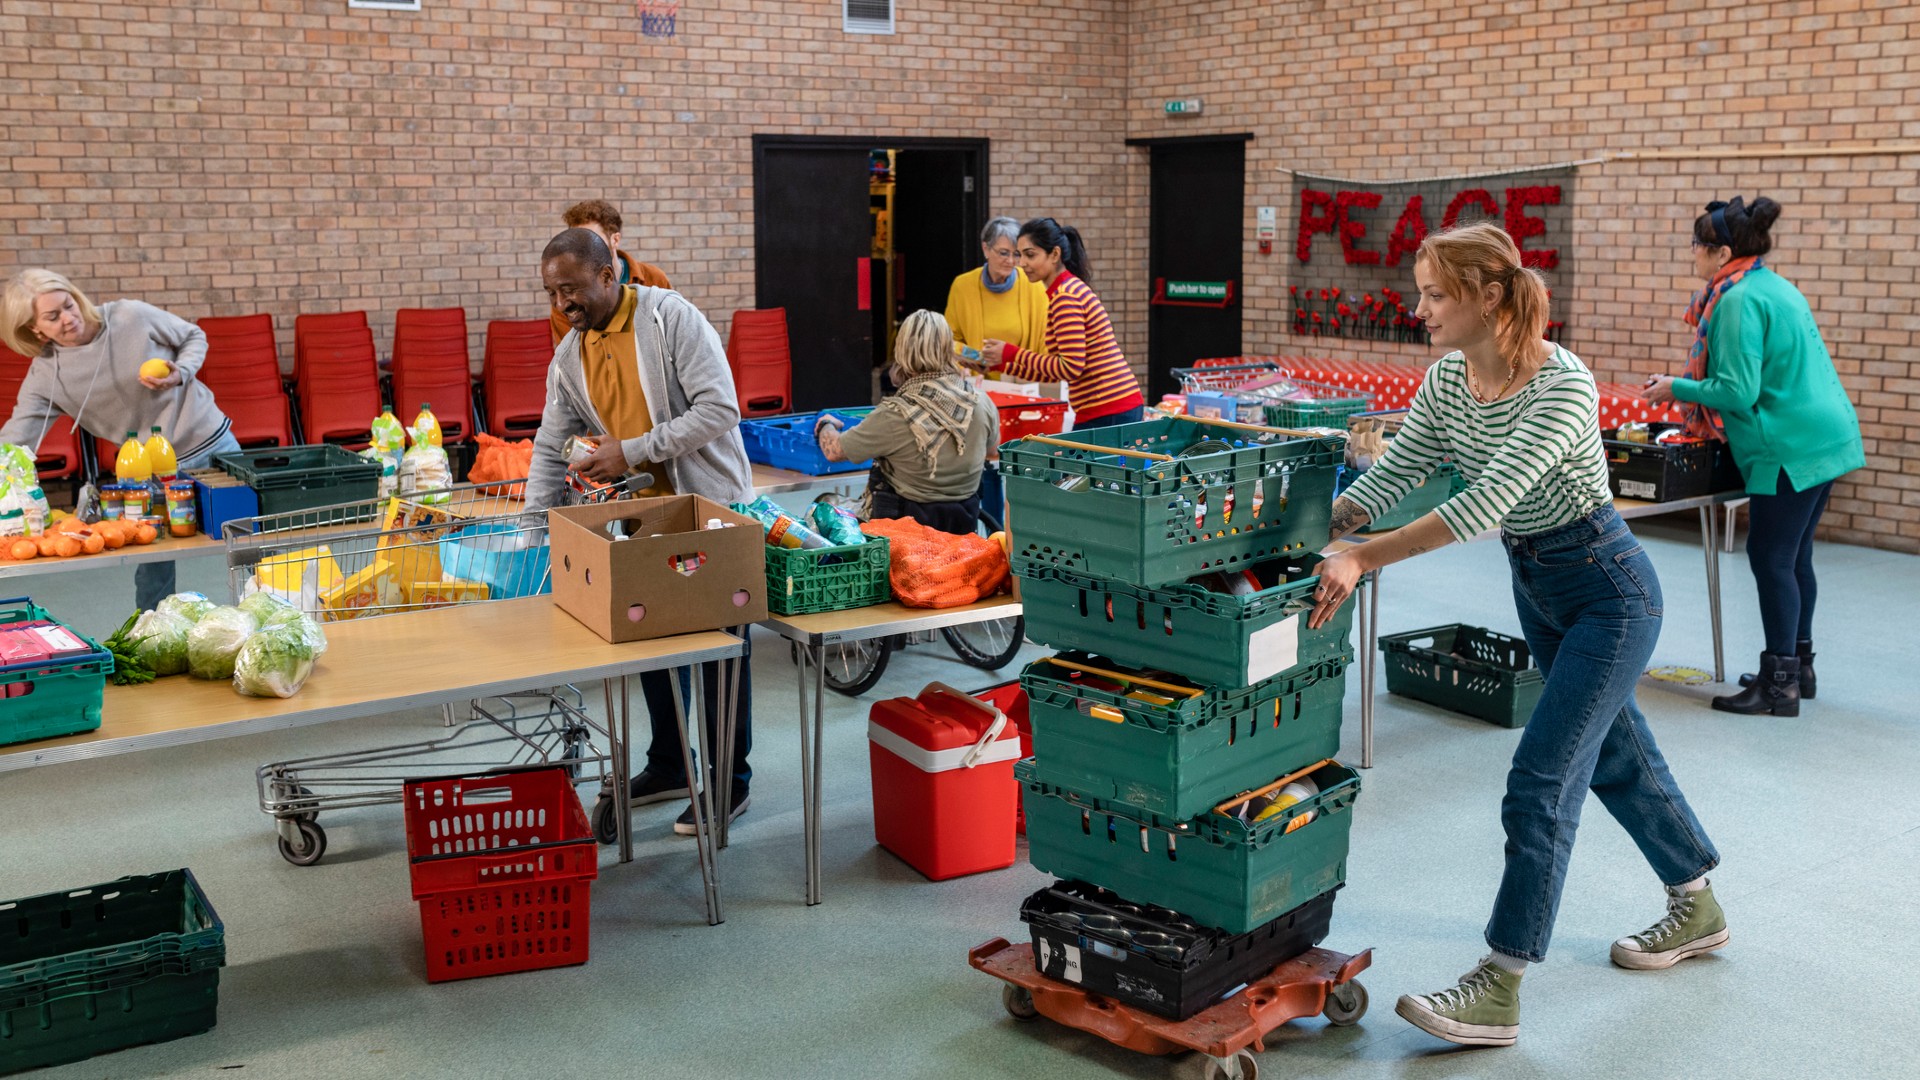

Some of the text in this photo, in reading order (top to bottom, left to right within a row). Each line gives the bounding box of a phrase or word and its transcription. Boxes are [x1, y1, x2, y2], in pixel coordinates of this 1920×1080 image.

[1169, 283, 1226, 296] Push bar to open
